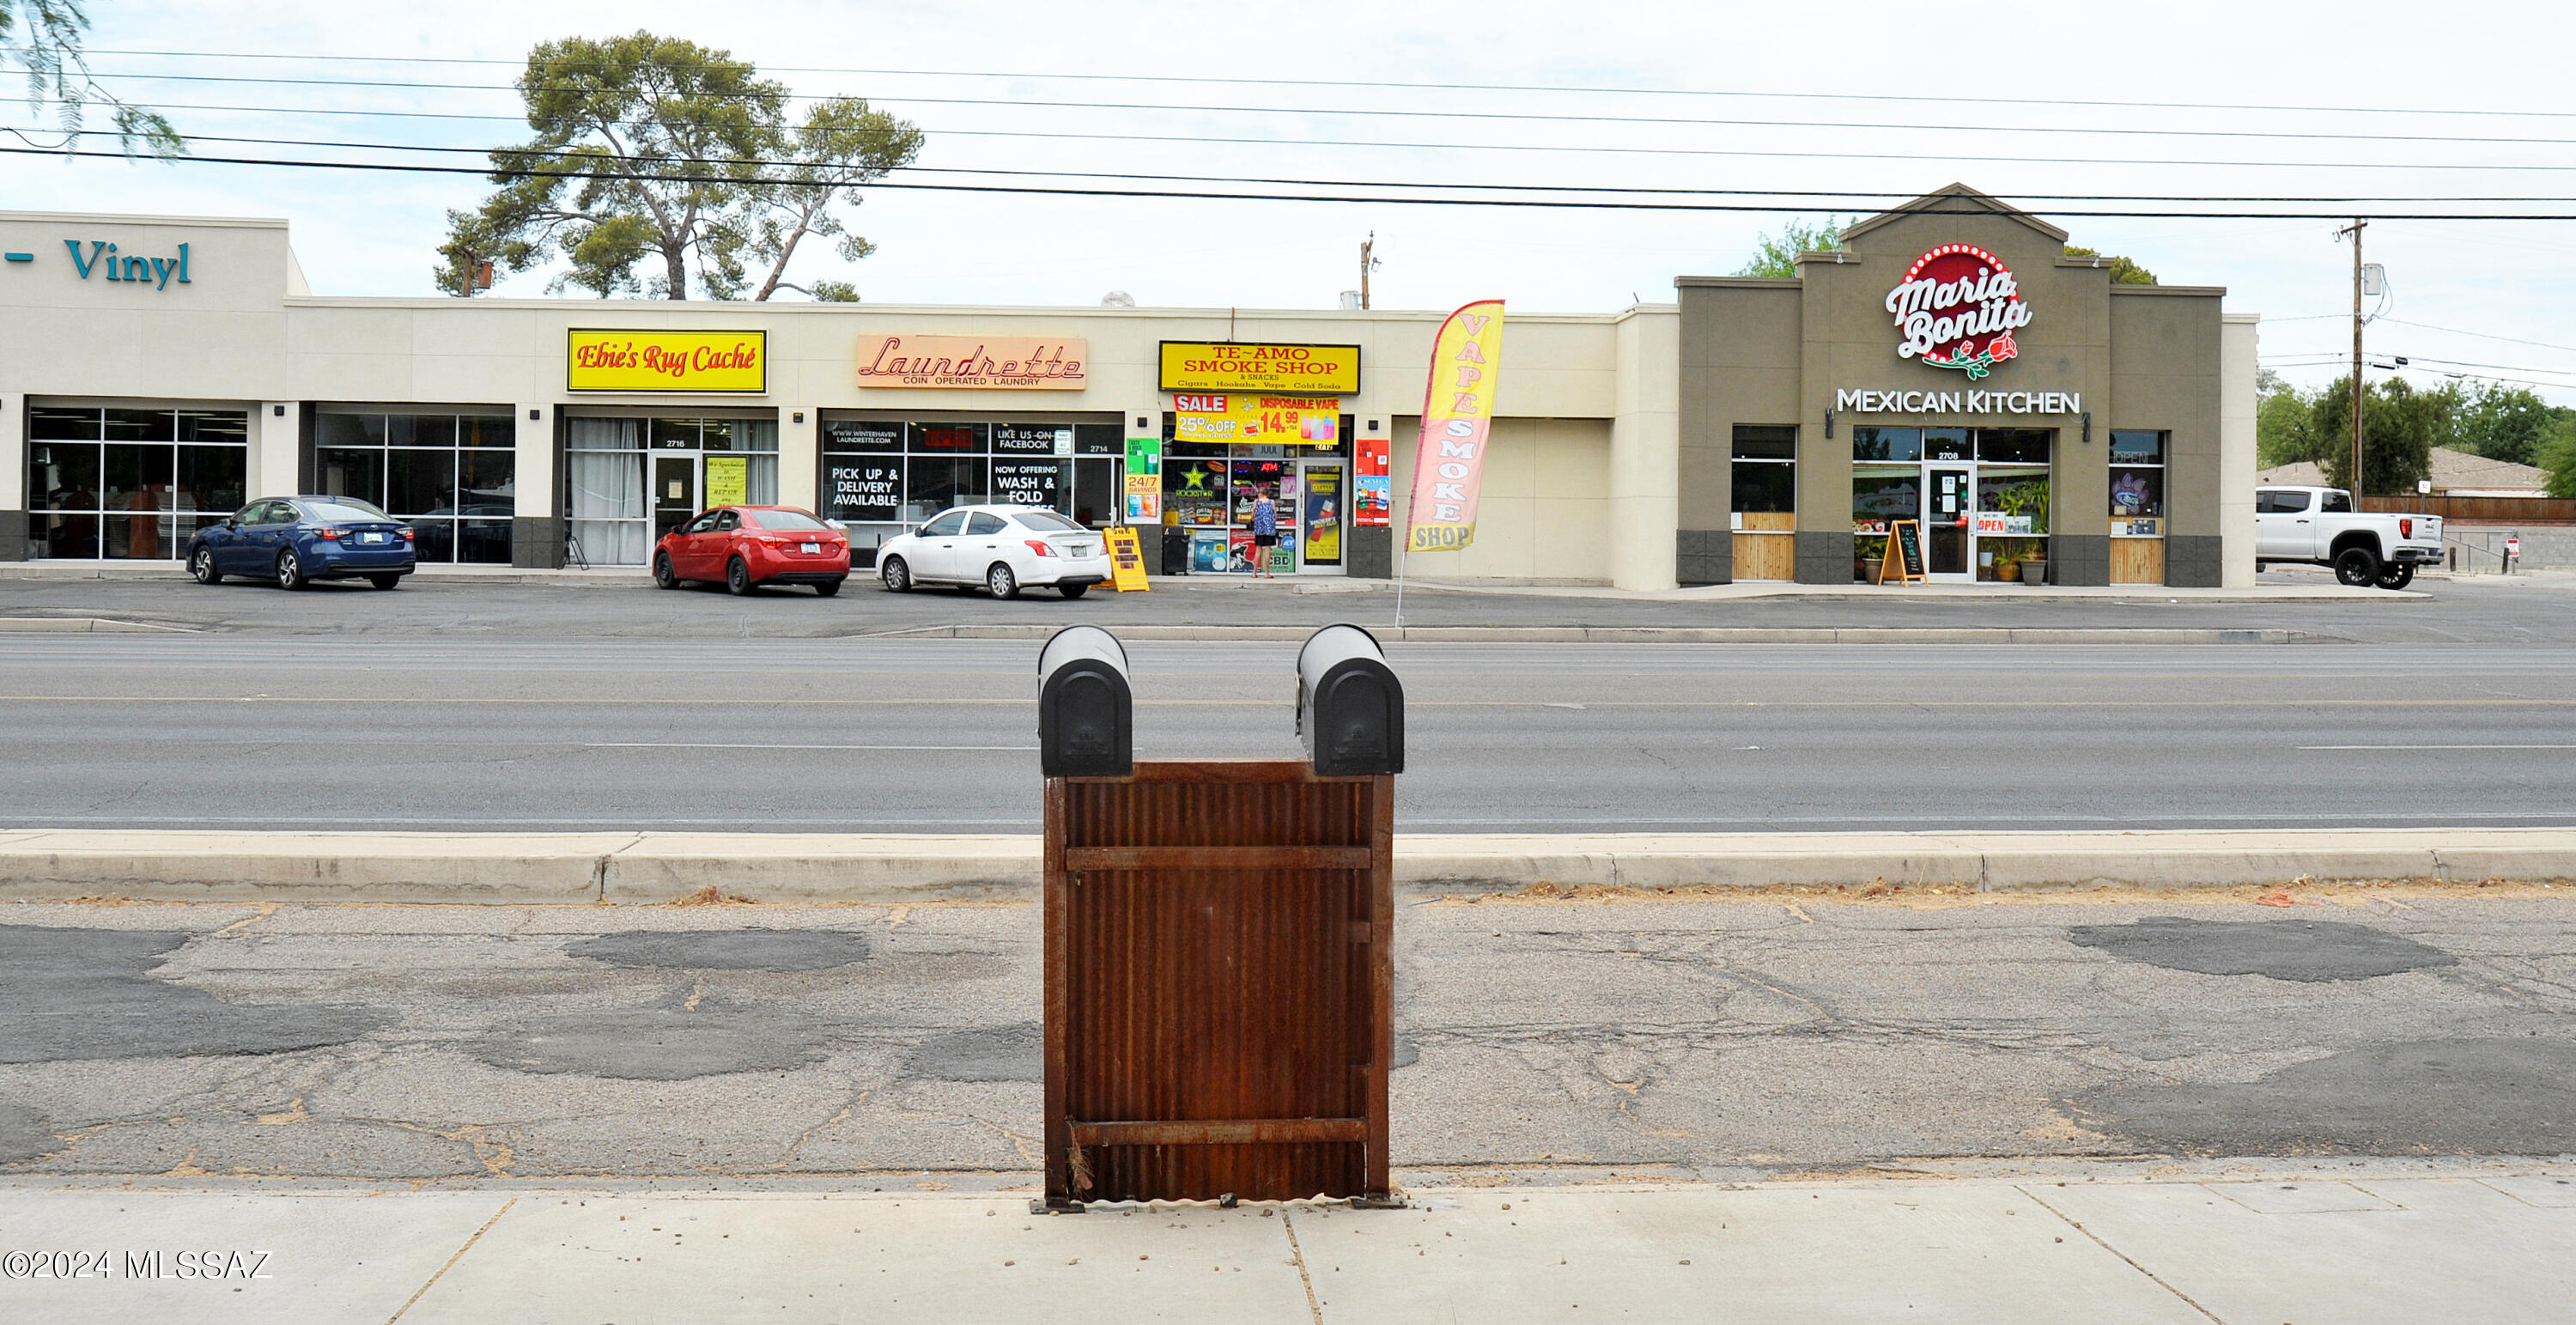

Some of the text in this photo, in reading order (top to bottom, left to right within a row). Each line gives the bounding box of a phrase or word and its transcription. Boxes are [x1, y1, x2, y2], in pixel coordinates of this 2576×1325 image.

[64, 240, 191, 290] Vinyl
[1885, 267, 2017, 326] Maria
[1898, 297, 2033, 359] Bonita
[577, 342, 756, 377] Ebie's Rug Caché
[858, 337, 1084, 379] Laundrette
[1450, 314, 1492, 414] VAPE
[1184, 360, 1339, 375] SMOKE SHOP
[935, 376, 987, 386] OPERATED
[993, 377, 1041, 386] LAUNDRY
[1177, 395, 1225, 411] SALE
[1260, 398, 1339, 410] DISPOSABLE VAPE
[1837, 388, 2081, 414] MEXICAN KITCHEN
[1179, 416, 1236, 433] 25% OFF
[998, 430, 1052, 440] LIKE US ON
[999, 440, 1049, 449] FACEBOOK
[1938, 452, 1959, 460] 2708
[2115, 452, 2148, 464] OPEN
[1019, 465, 1058, 474] OFFERING
[1261, 462, 1279, 471] ATM
[1433, 420, 1475, 523] SMOKE
[832, 468, 898, 481] PICK UP &
[837, 481, 893, 494] DELIVERY
[998, 477, 1055, 489] WASH &
[1128, 477, 1157, 487] 24/7
[833, 495, 898, 507] AVAILABLE
[1008, 490, 1043, 503] FOLD
[1979, 520, 2004, 532] OPEN
[1415, 526, 1470, 547] SHOP
